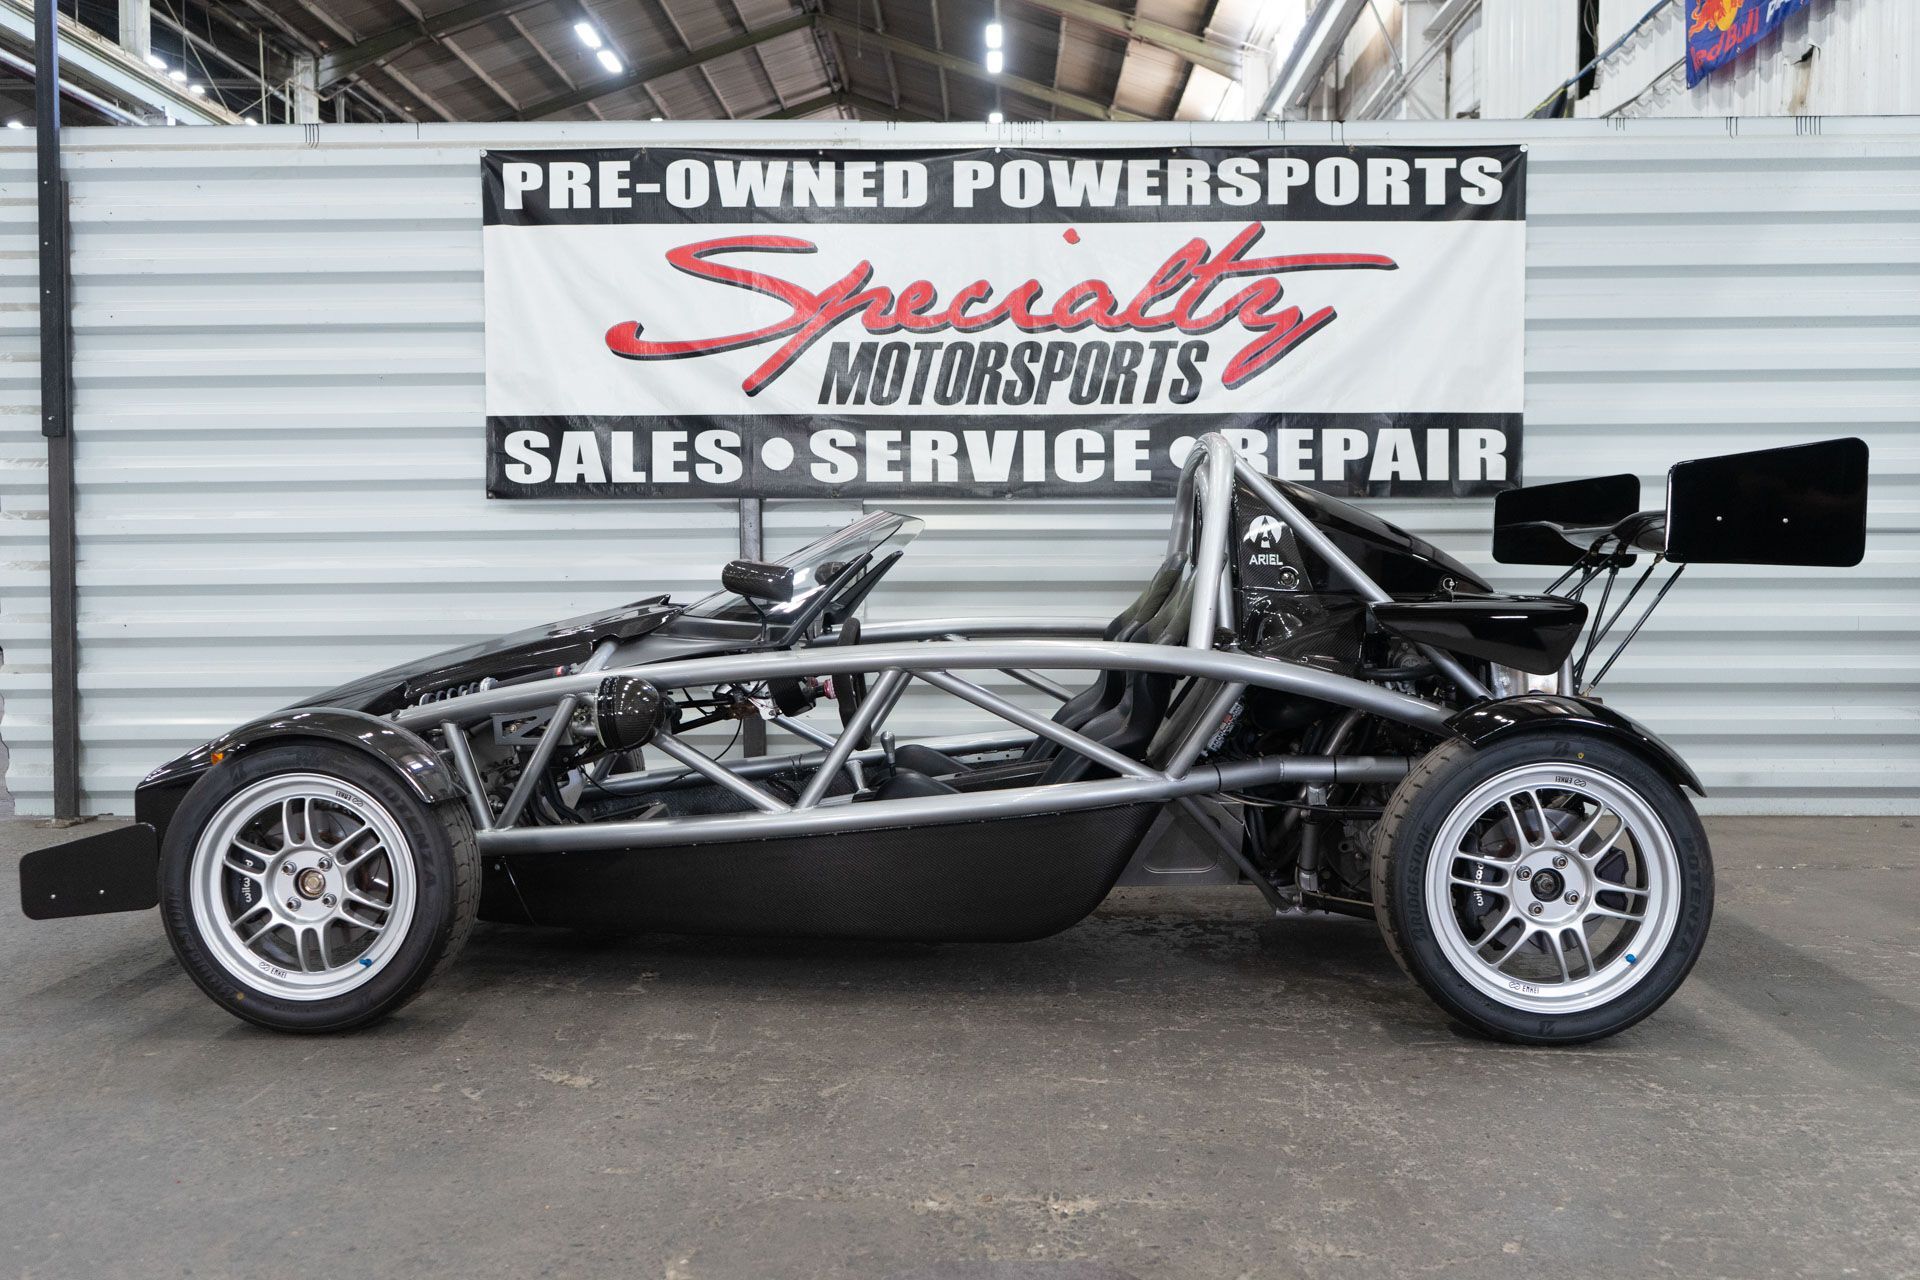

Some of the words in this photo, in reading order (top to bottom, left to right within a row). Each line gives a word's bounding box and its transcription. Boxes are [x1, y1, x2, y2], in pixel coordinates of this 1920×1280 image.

[1724, 7, 1760, 54] Bull
[502, 159, 928, 210] PRE-OWNED
[953, 156, 1503, 208] POWERSPORTS
[605, 220, 1399, 397] Specialty
[818, 340, 1209, 406] MOTORSPORTS
[504, 429, 744, 484] SALES
[810, 428, 1152, 484] SERVICE
[1221, 428, 1508, 482] REPAIR
[1248, 554, 1283, 566] ARIEL
